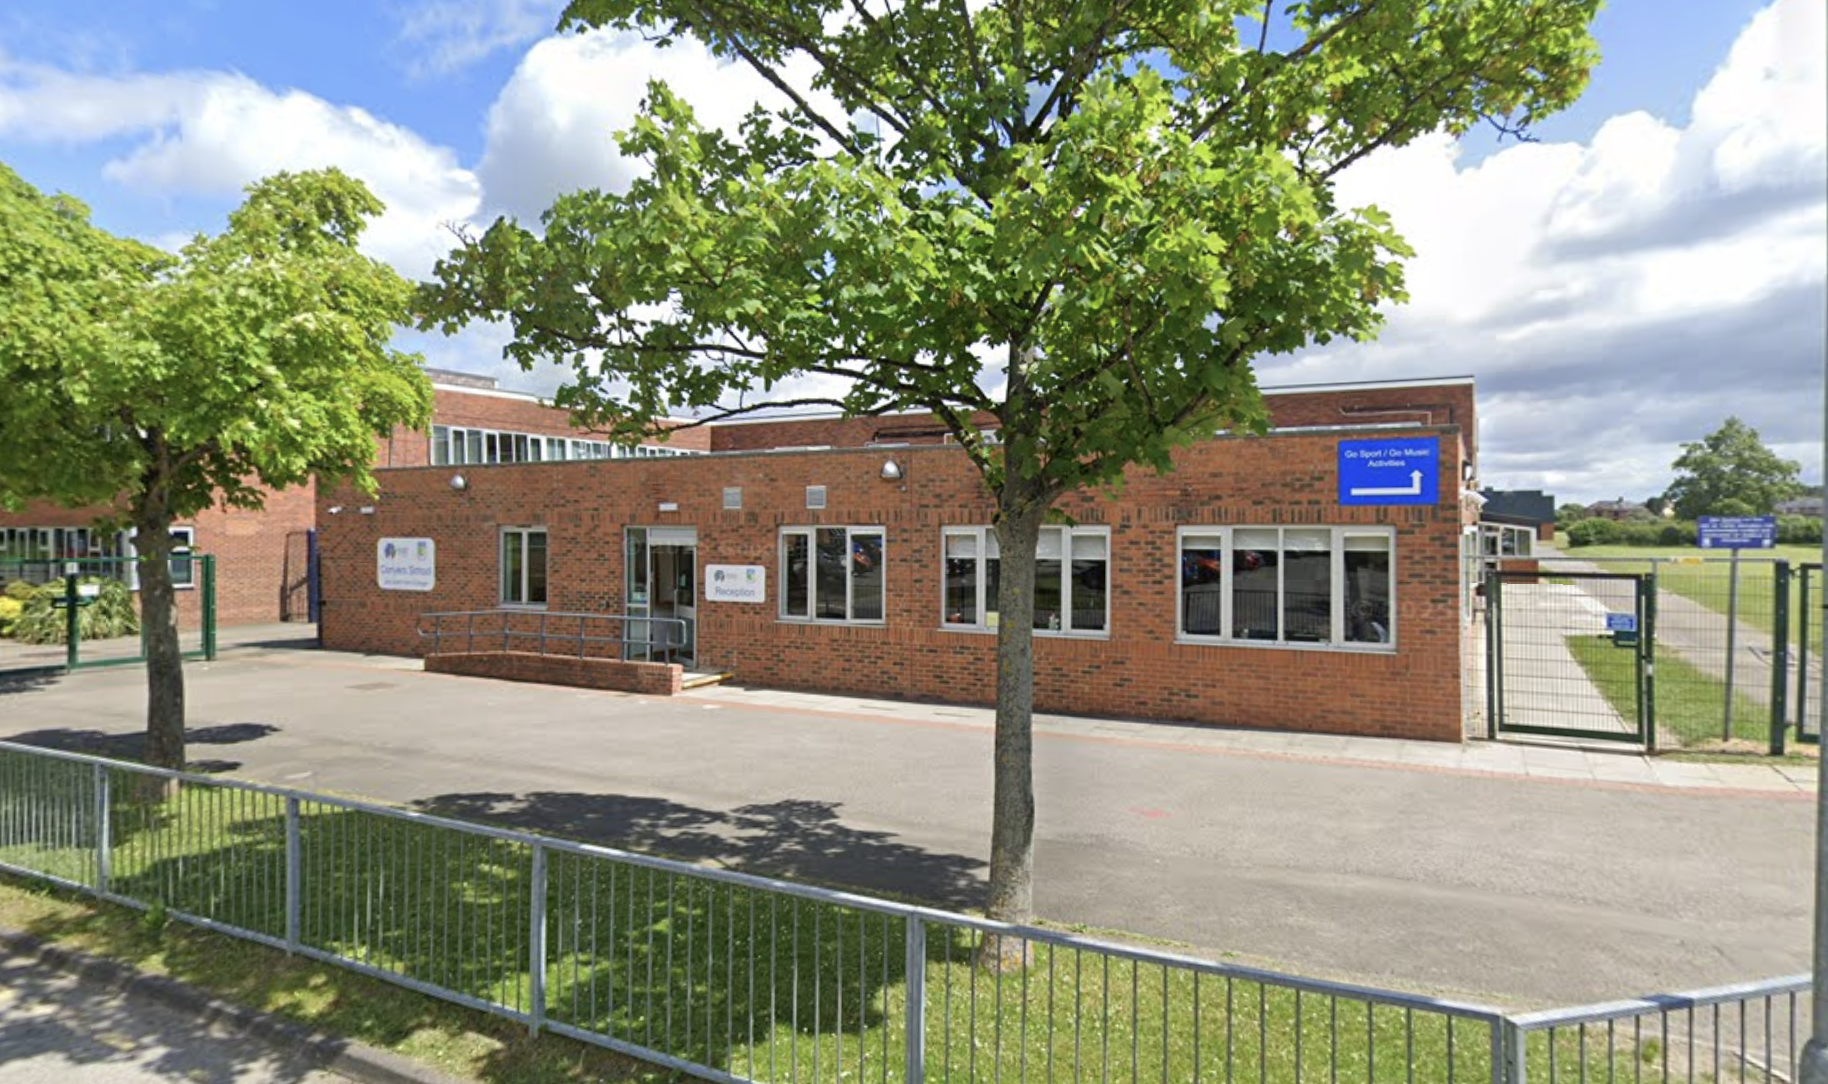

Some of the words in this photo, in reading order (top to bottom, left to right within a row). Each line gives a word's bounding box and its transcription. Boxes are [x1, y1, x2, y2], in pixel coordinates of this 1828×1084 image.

[1344, 450, 1359, 459] Go
[1359, 449, 1382, 459] Sport
[1388, 449, 1402, 458] Go
[1404, 448, 1430, 457] Music
[1367, 459, 1406, 467] Activities
[409, 564, 432, 576] School
[715, 586, 755, 597] Reception
